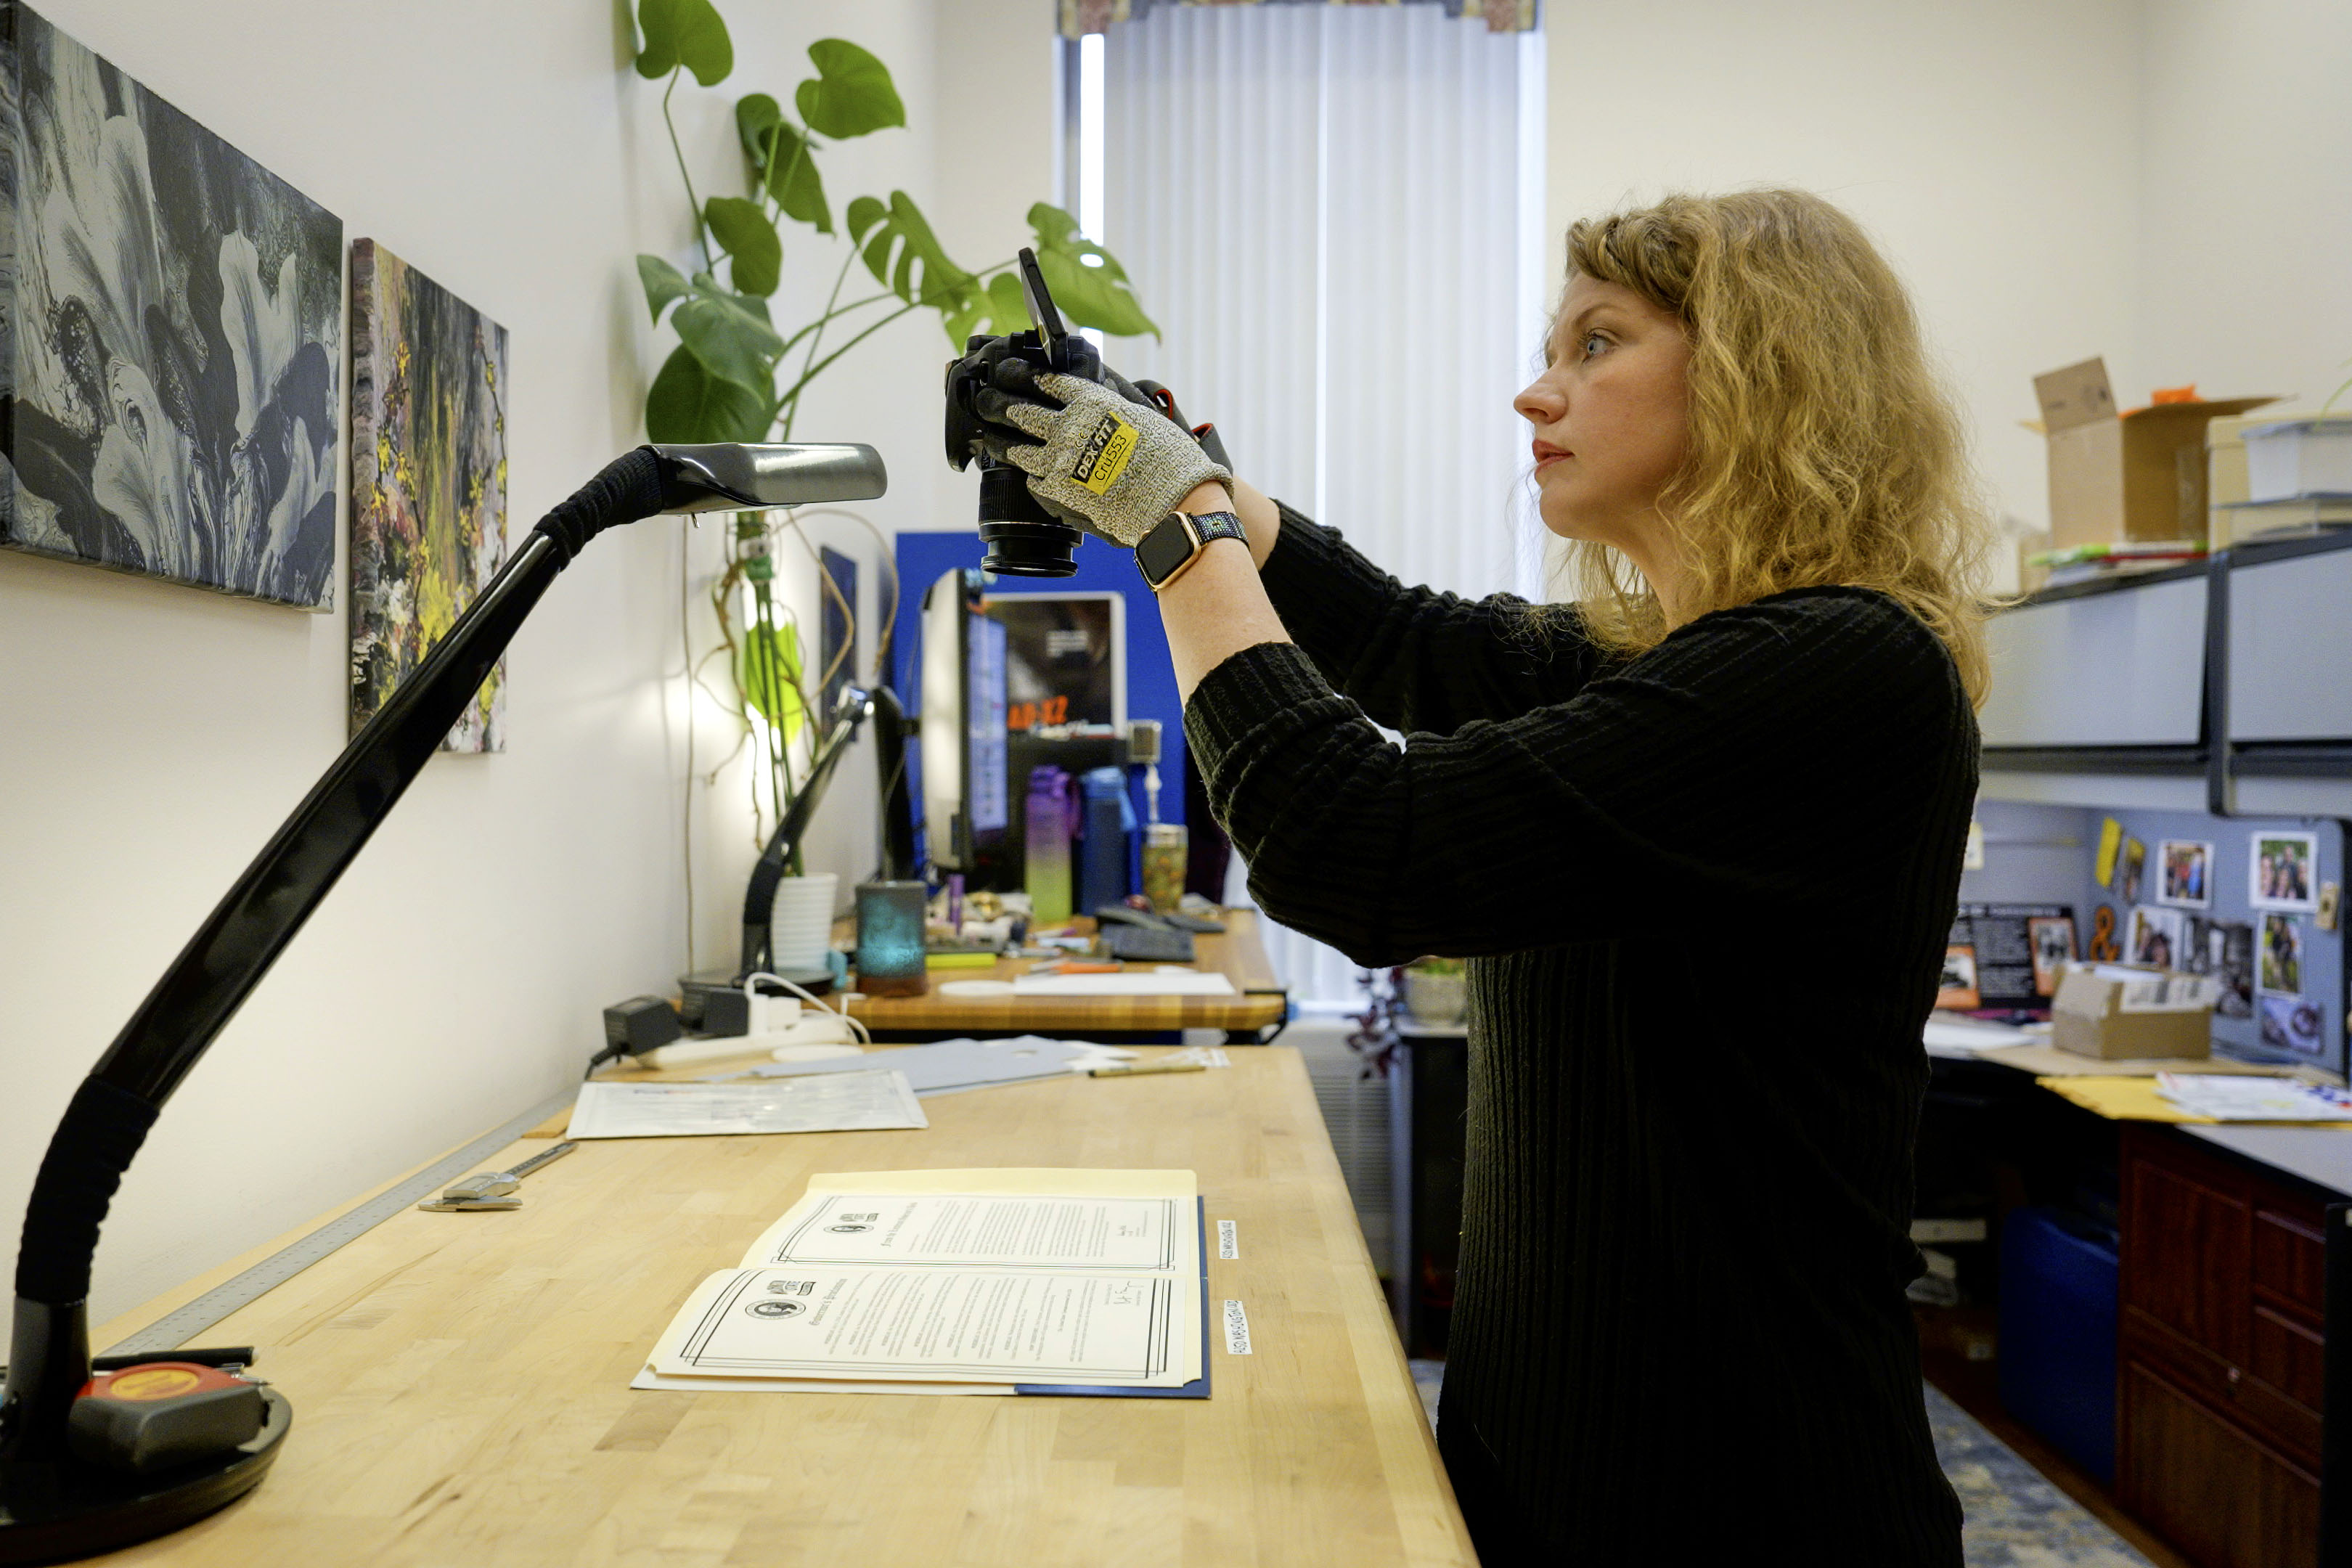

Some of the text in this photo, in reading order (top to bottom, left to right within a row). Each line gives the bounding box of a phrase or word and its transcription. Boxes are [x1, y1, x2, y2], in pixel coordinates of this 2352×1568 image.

[1077, 420, 1112, 479] DEX FIT
[1094, 434, 1127, 481] Cru553
